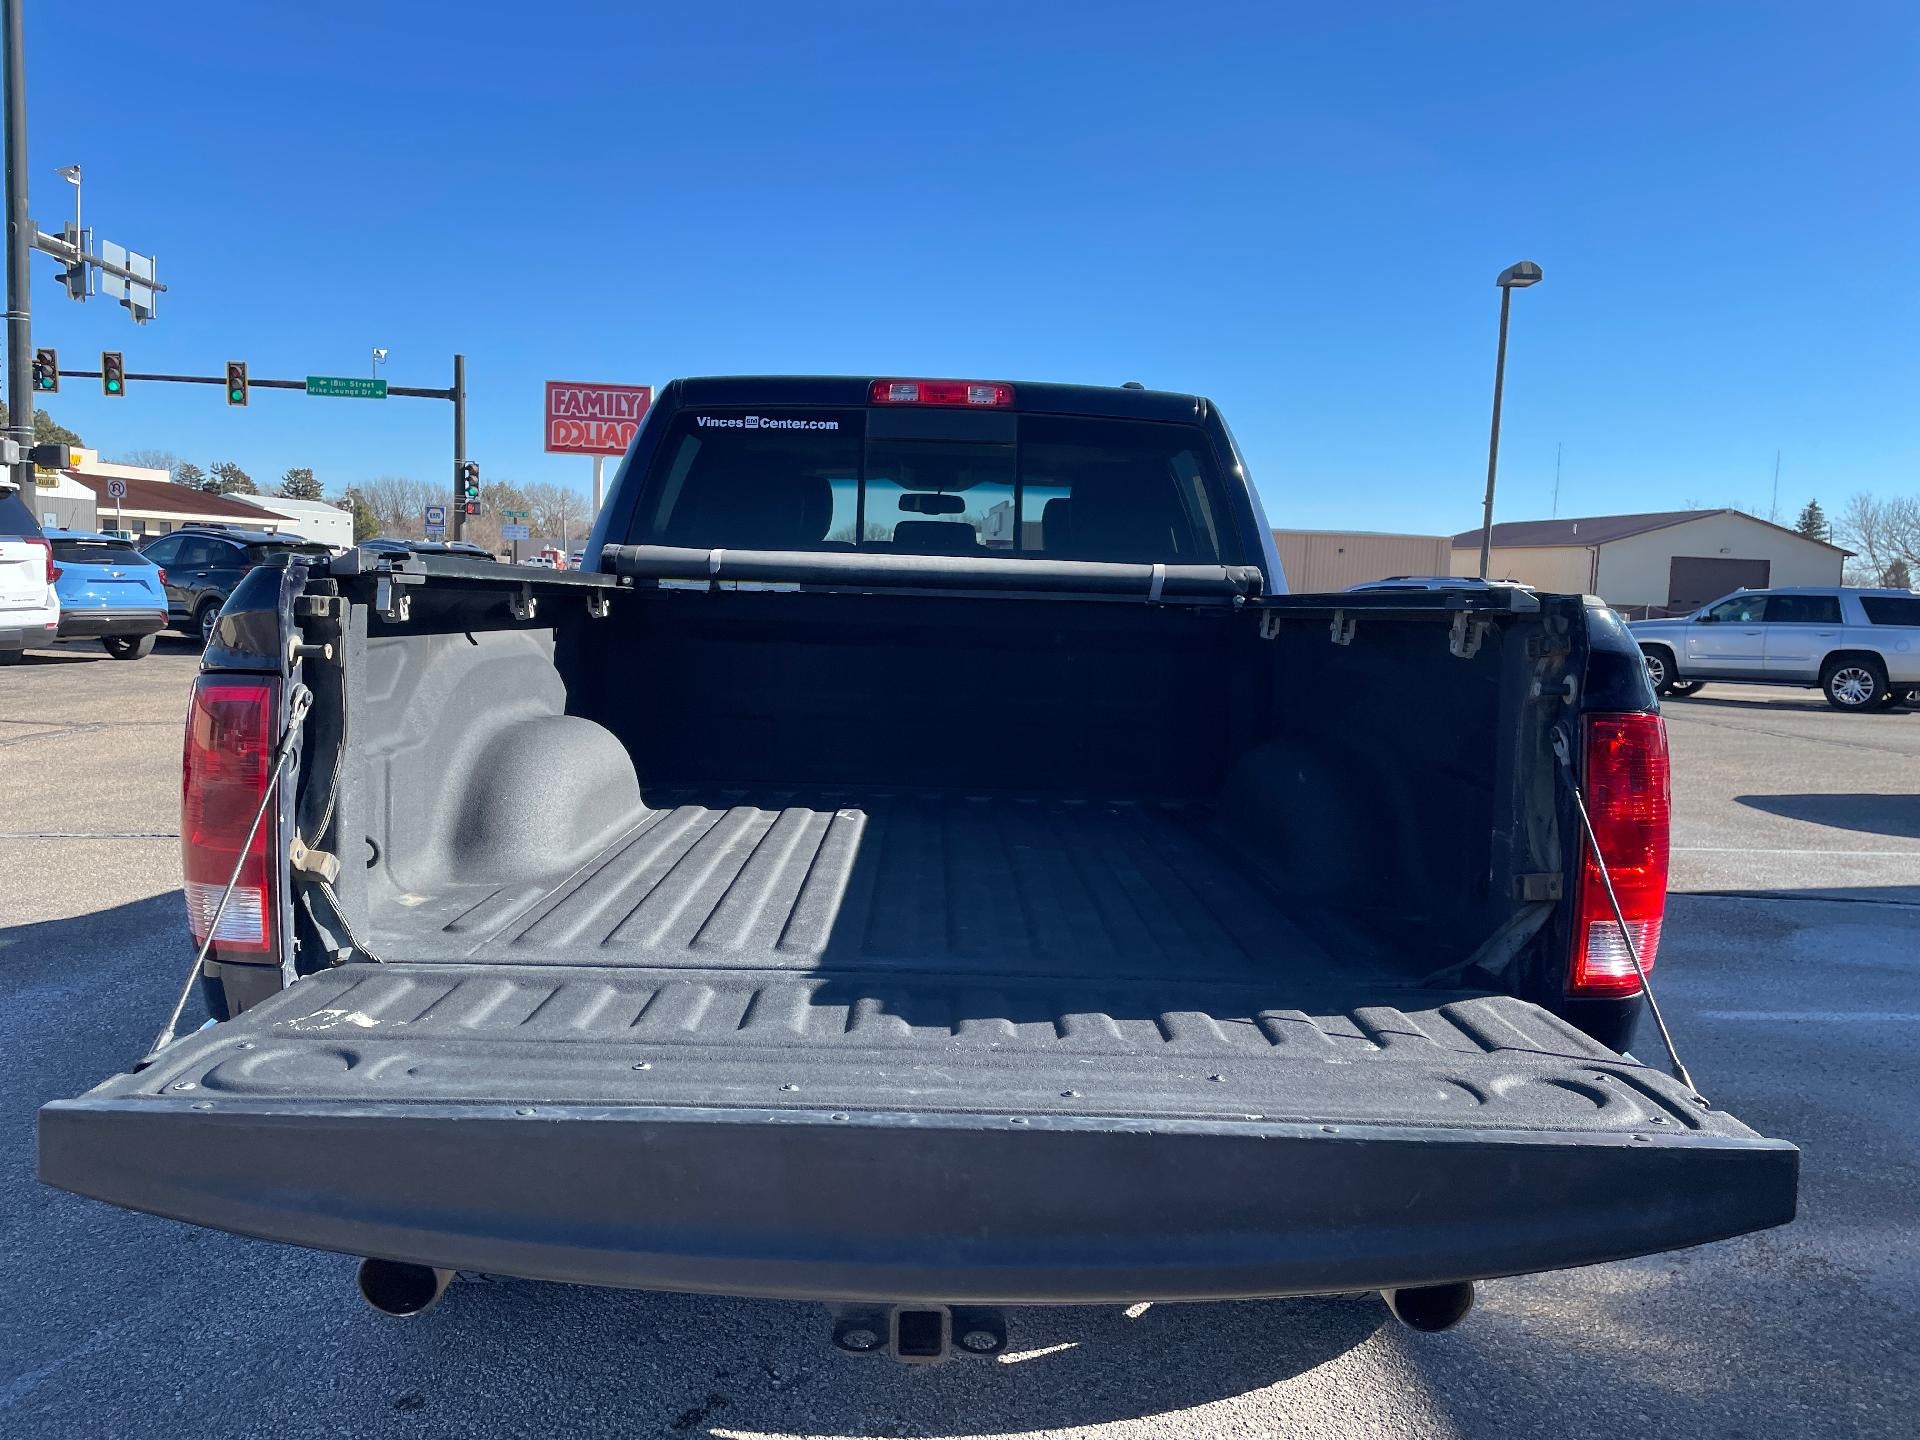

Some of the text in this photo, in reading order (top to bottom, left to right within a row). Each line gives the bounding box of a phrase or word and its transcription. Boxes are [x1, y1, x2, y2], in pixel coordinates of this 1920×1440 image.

[349, 380, 375, 388] Street
[329, 388, 359, 396] Lounge
[552, 389, 644, 419] FAMILY
